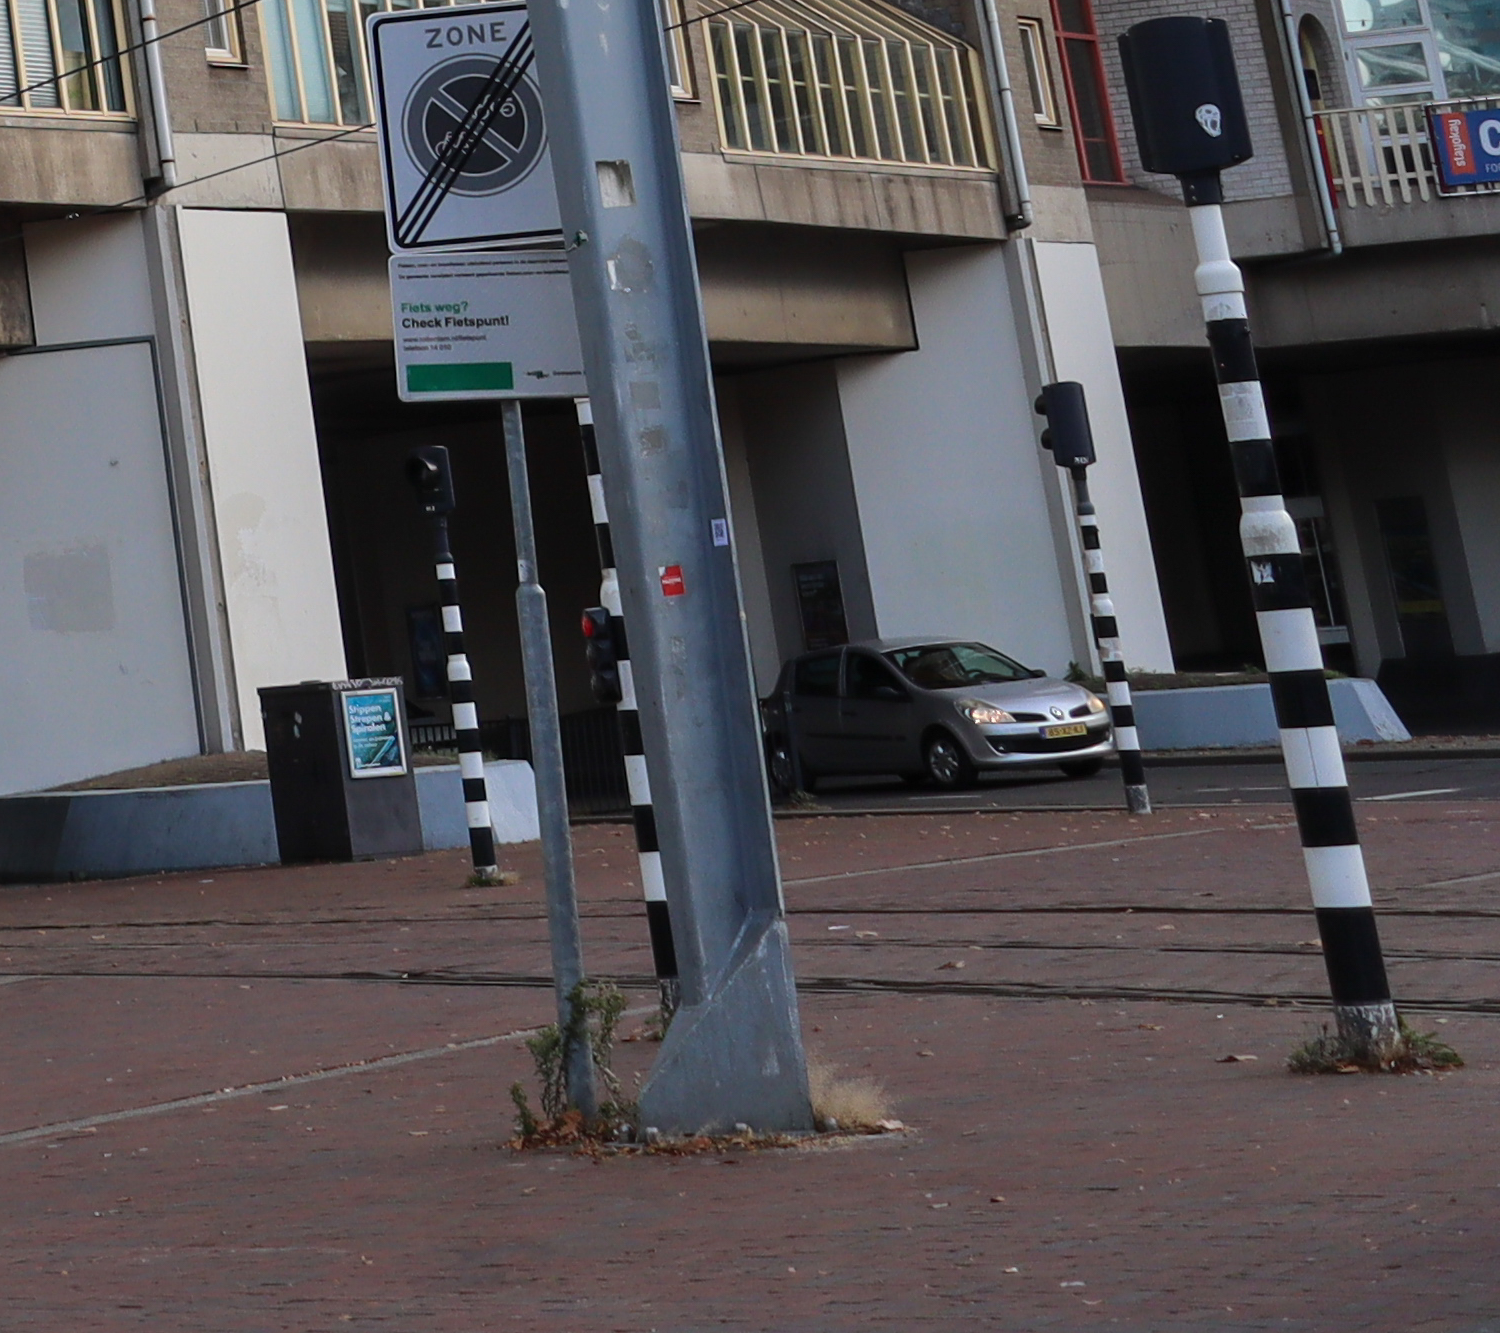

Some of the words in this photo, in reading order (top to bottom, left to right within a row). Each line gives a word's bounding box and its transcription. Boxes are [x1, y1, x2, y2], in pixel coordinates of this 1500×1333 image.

[424, 21, 507, 49] ZONE
[1448, 119, 1466, 167] stayokay
[401, 302, 431, 313] Fiets
[435, 300, 469, 314] weg?
[402, 317, 442, 328] Check
[445, 315, 509, 329] Fietspunt!
